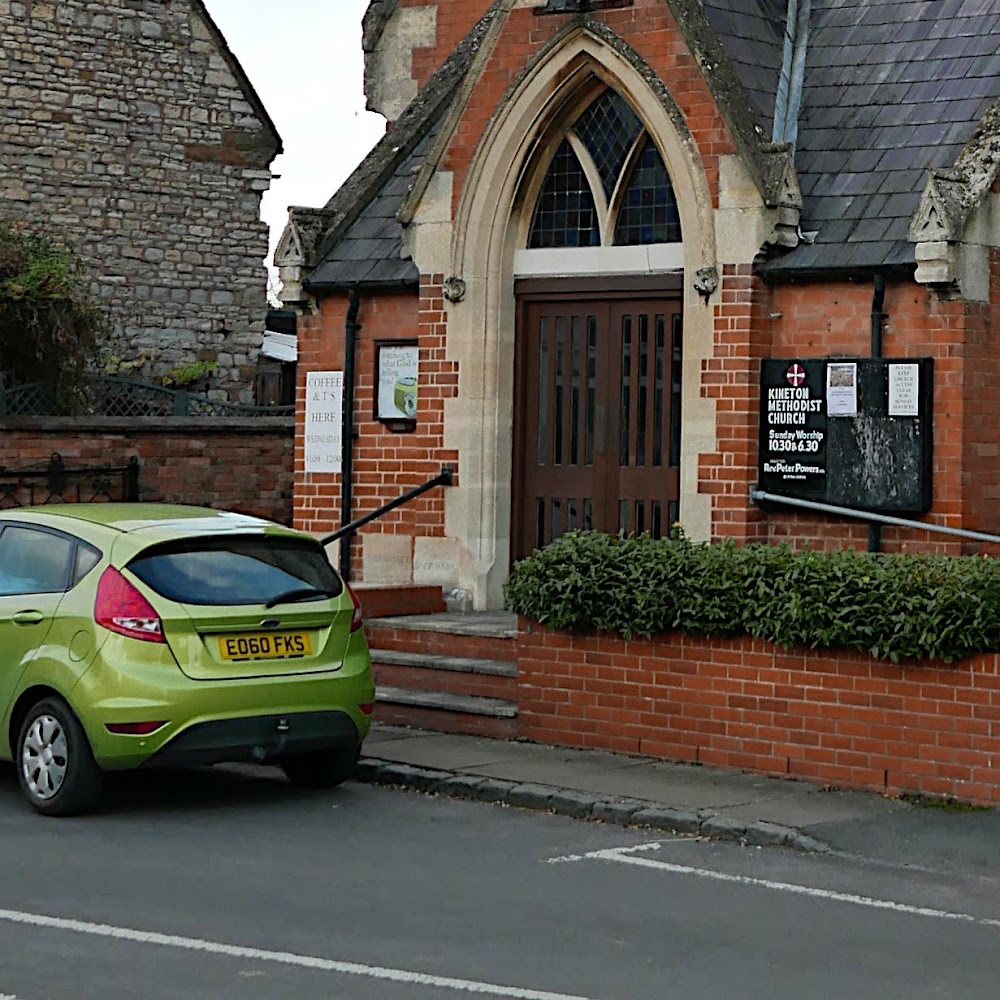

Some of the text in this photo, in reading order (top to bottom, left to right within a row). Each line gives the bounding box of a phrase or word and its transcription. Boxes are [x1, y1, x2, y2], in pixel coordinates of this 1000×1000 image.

[308, 377, 342, 388] COFFEE
[312, 391, 320, 401] &
[768, 387, 810, 400] KINETON
[767, 399, 823, 412] METHODIST
[311, 412, 336, 423] HERE
[767, 412, 806, 425] CHURCH
[306, 434, 340, 443] WEDNESDAY
[768, 429, 824, 442] Sunday Worship
[776, 462, 795, 472] Peter
[273, 635, 305, 653] FKS
